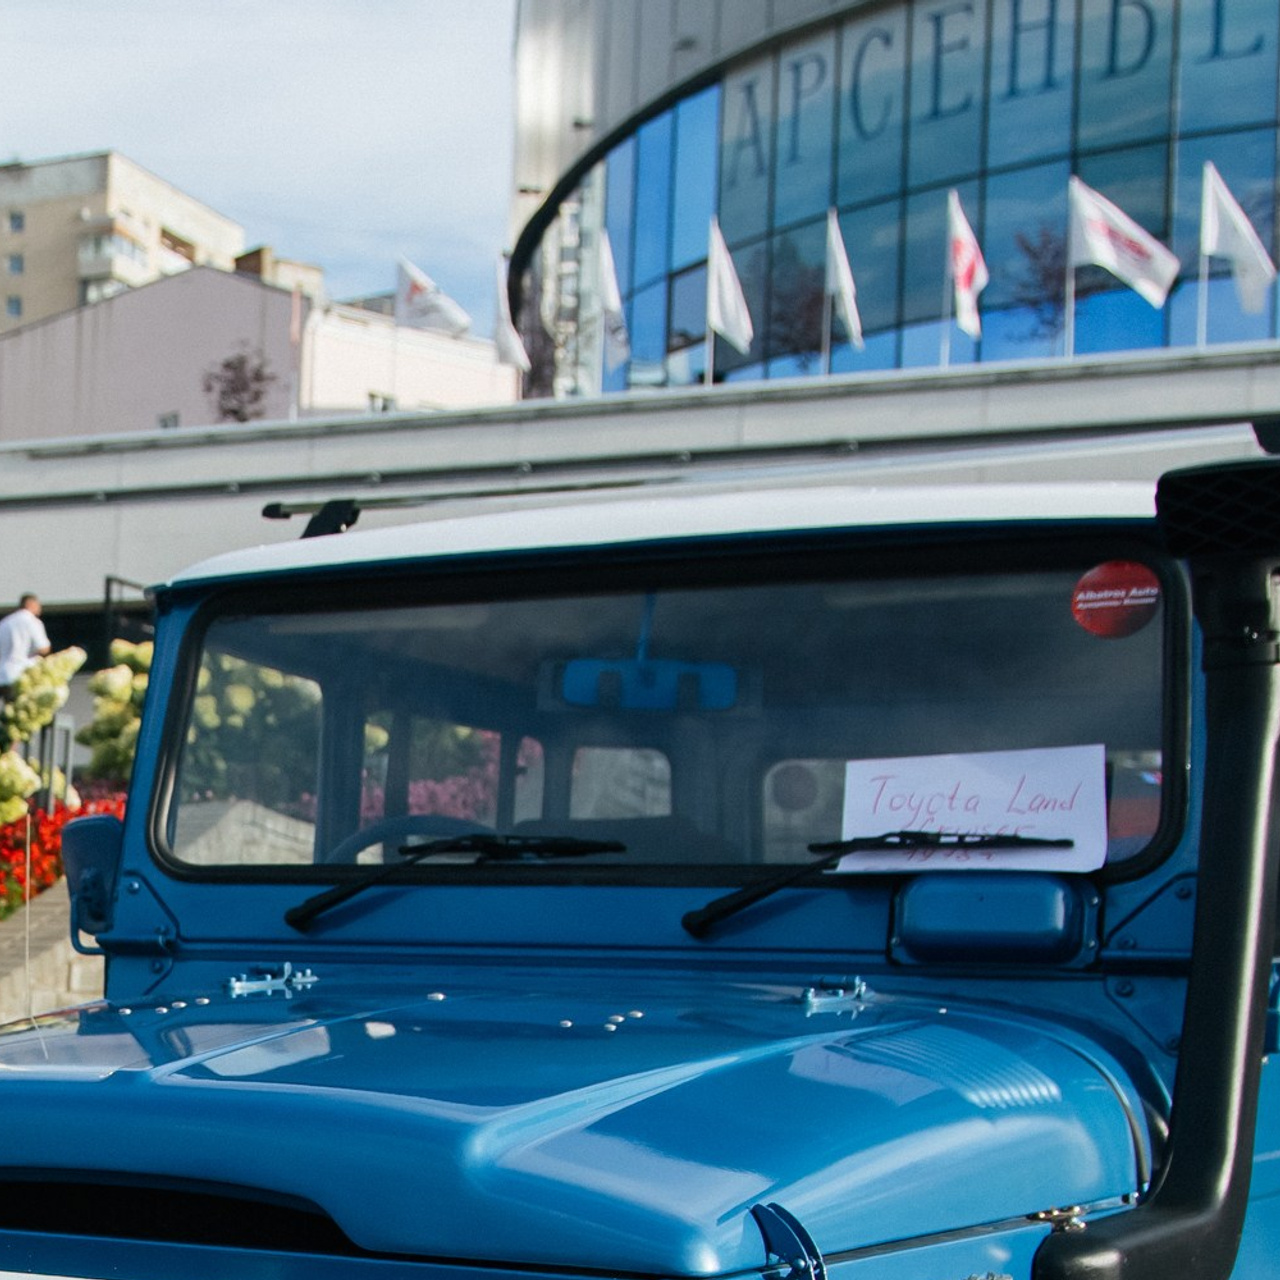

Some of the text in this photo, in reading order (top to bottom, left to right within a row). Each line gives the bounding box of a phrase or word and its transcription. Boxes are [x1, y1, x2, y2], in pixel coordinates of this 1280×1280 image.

[1129, 587, 1159, 597] Auto
[869, 773, 1083, 830] Toyota Land
